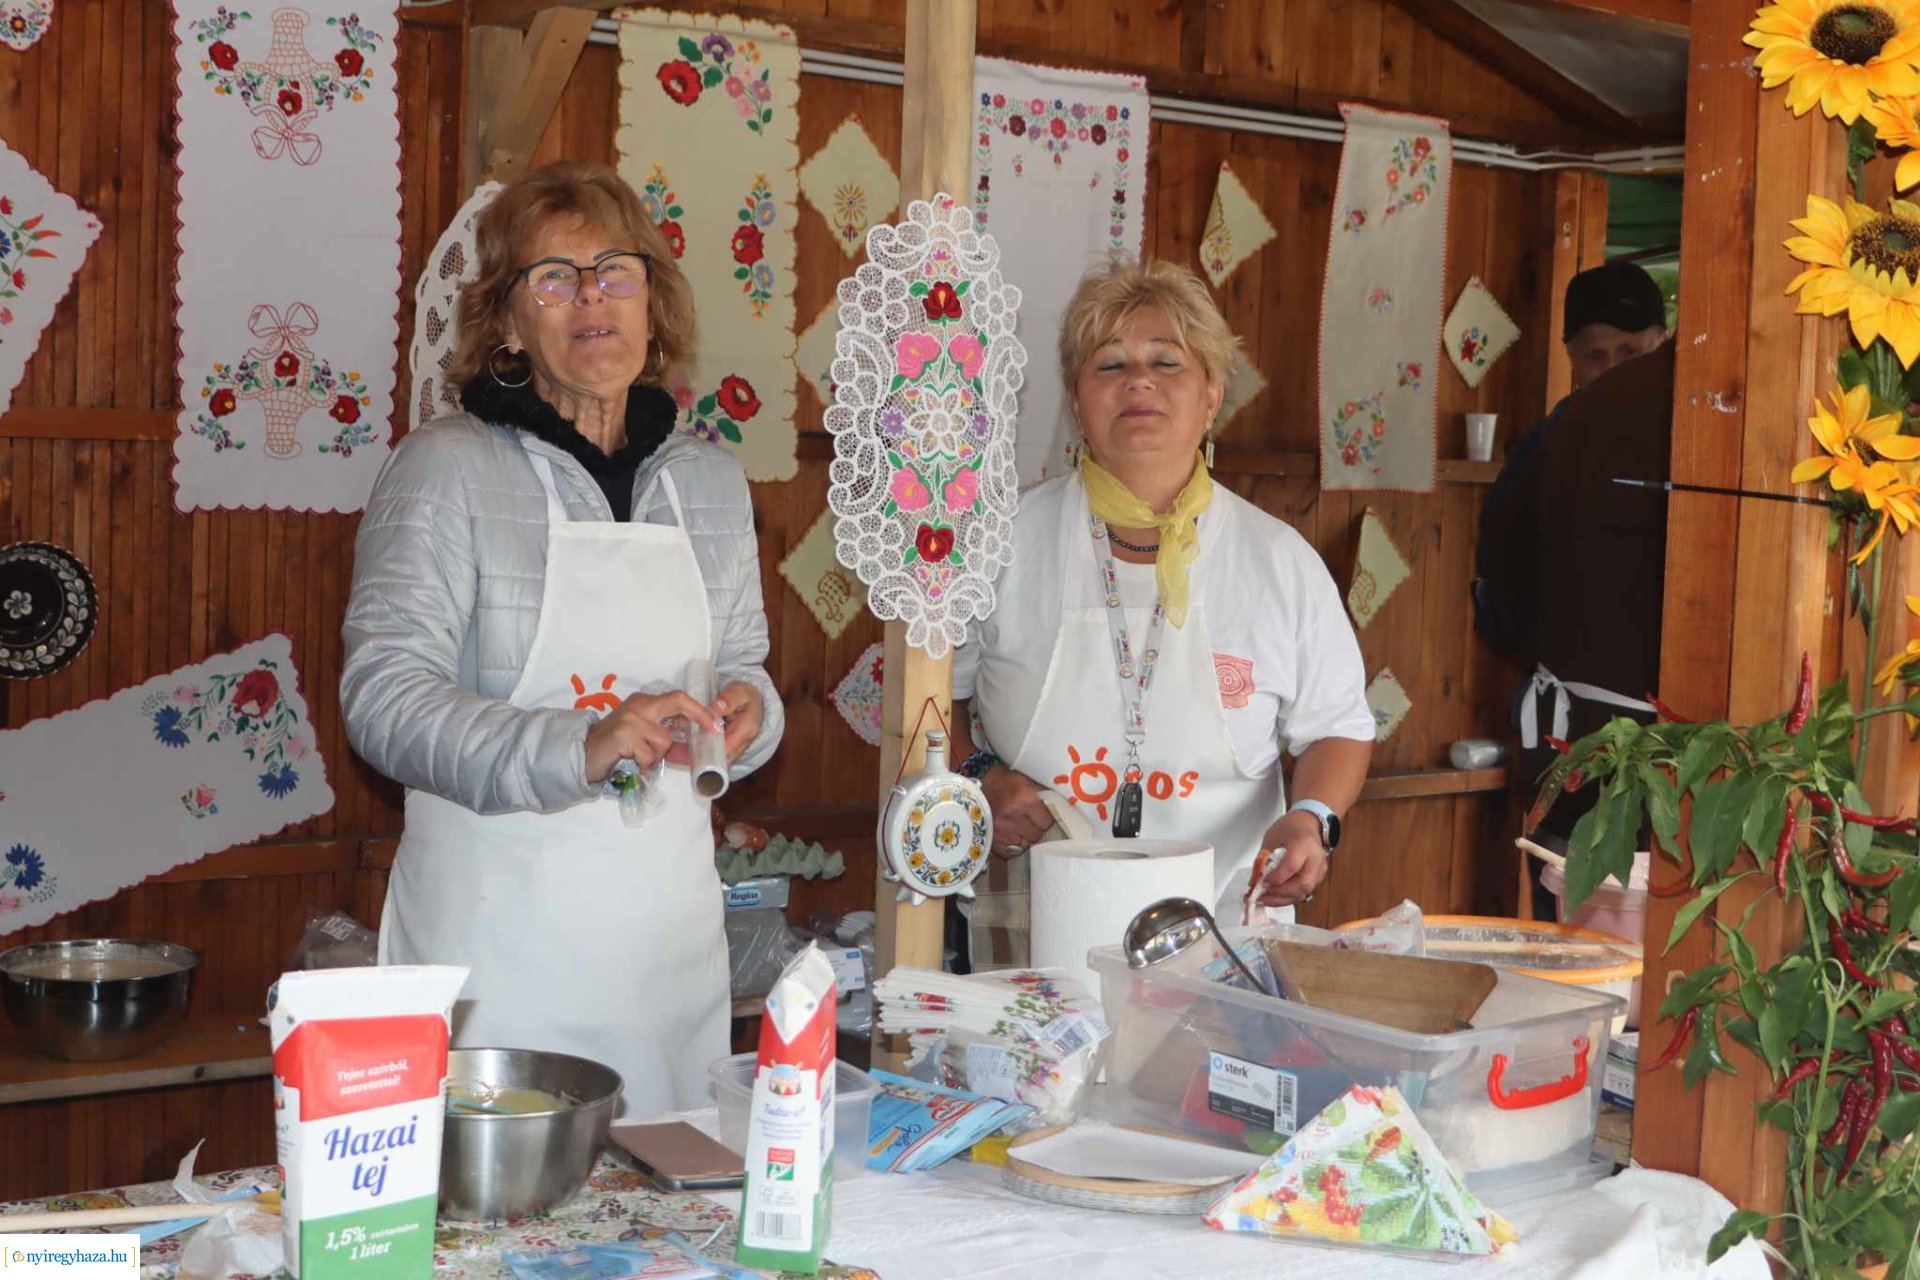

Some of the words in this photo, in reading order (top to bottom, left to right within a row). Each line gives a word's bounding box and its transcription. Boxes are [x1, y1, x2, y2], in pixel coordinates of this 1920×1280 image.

[730, 890, 758, 901] Regina
[1224, 1062, 1249, 1079] sterk
[323, 1115, 419, 1161] Hazai
[352, 1155, 389, 1197] tej
[324, 1225, 367, 1252] 1,5%
[349, 1246, 360, 1261] 1
[359, 1241, 393, 1259] liter
